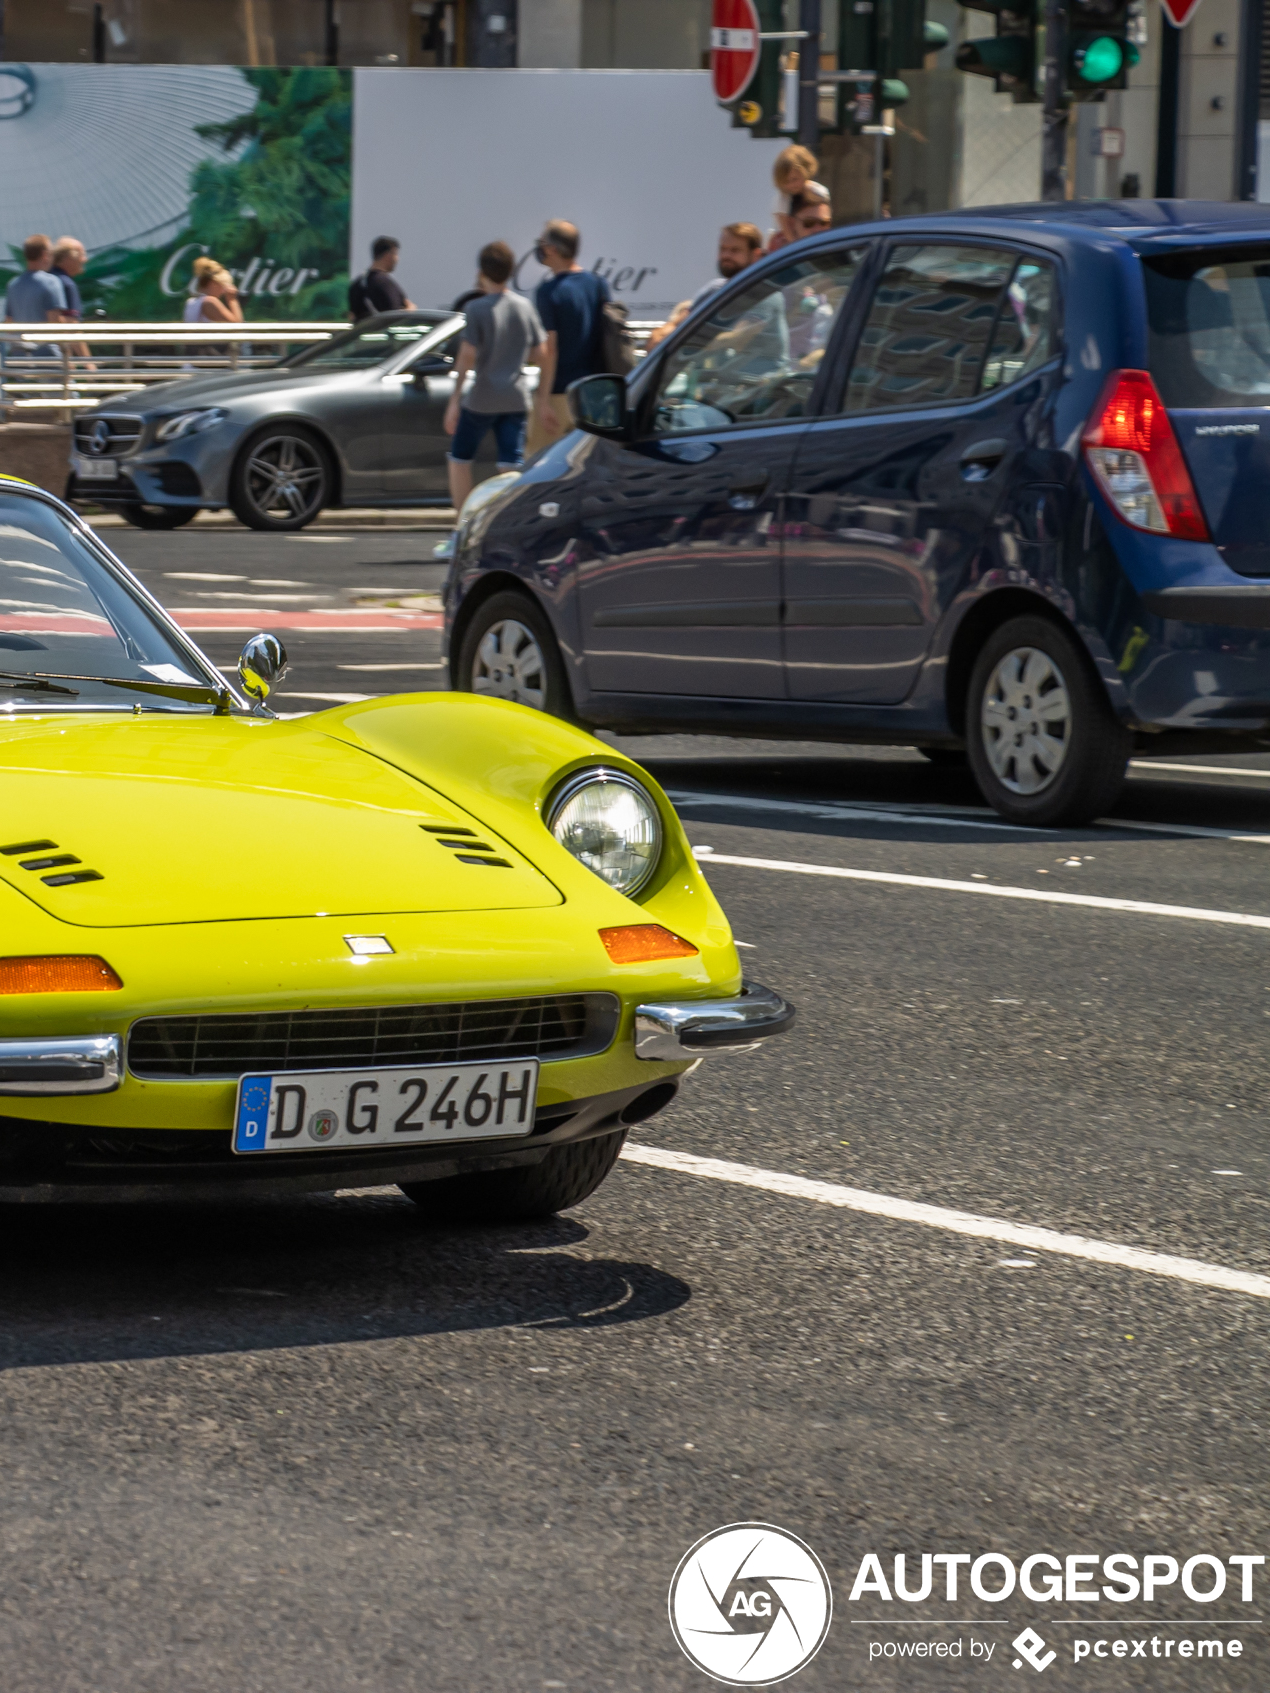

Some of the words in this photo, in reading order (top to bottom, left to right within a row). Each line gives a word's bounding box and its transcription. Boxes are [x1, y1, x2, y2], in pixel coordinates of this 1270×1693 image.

[511, 247, 658, 292] Ctier
[271, 1084, 307, 1139] D
[346, 1080, 379, 1135] G
[394, 1069, 532, 1133] 246H
[245, 1121, 258, 1138] D
